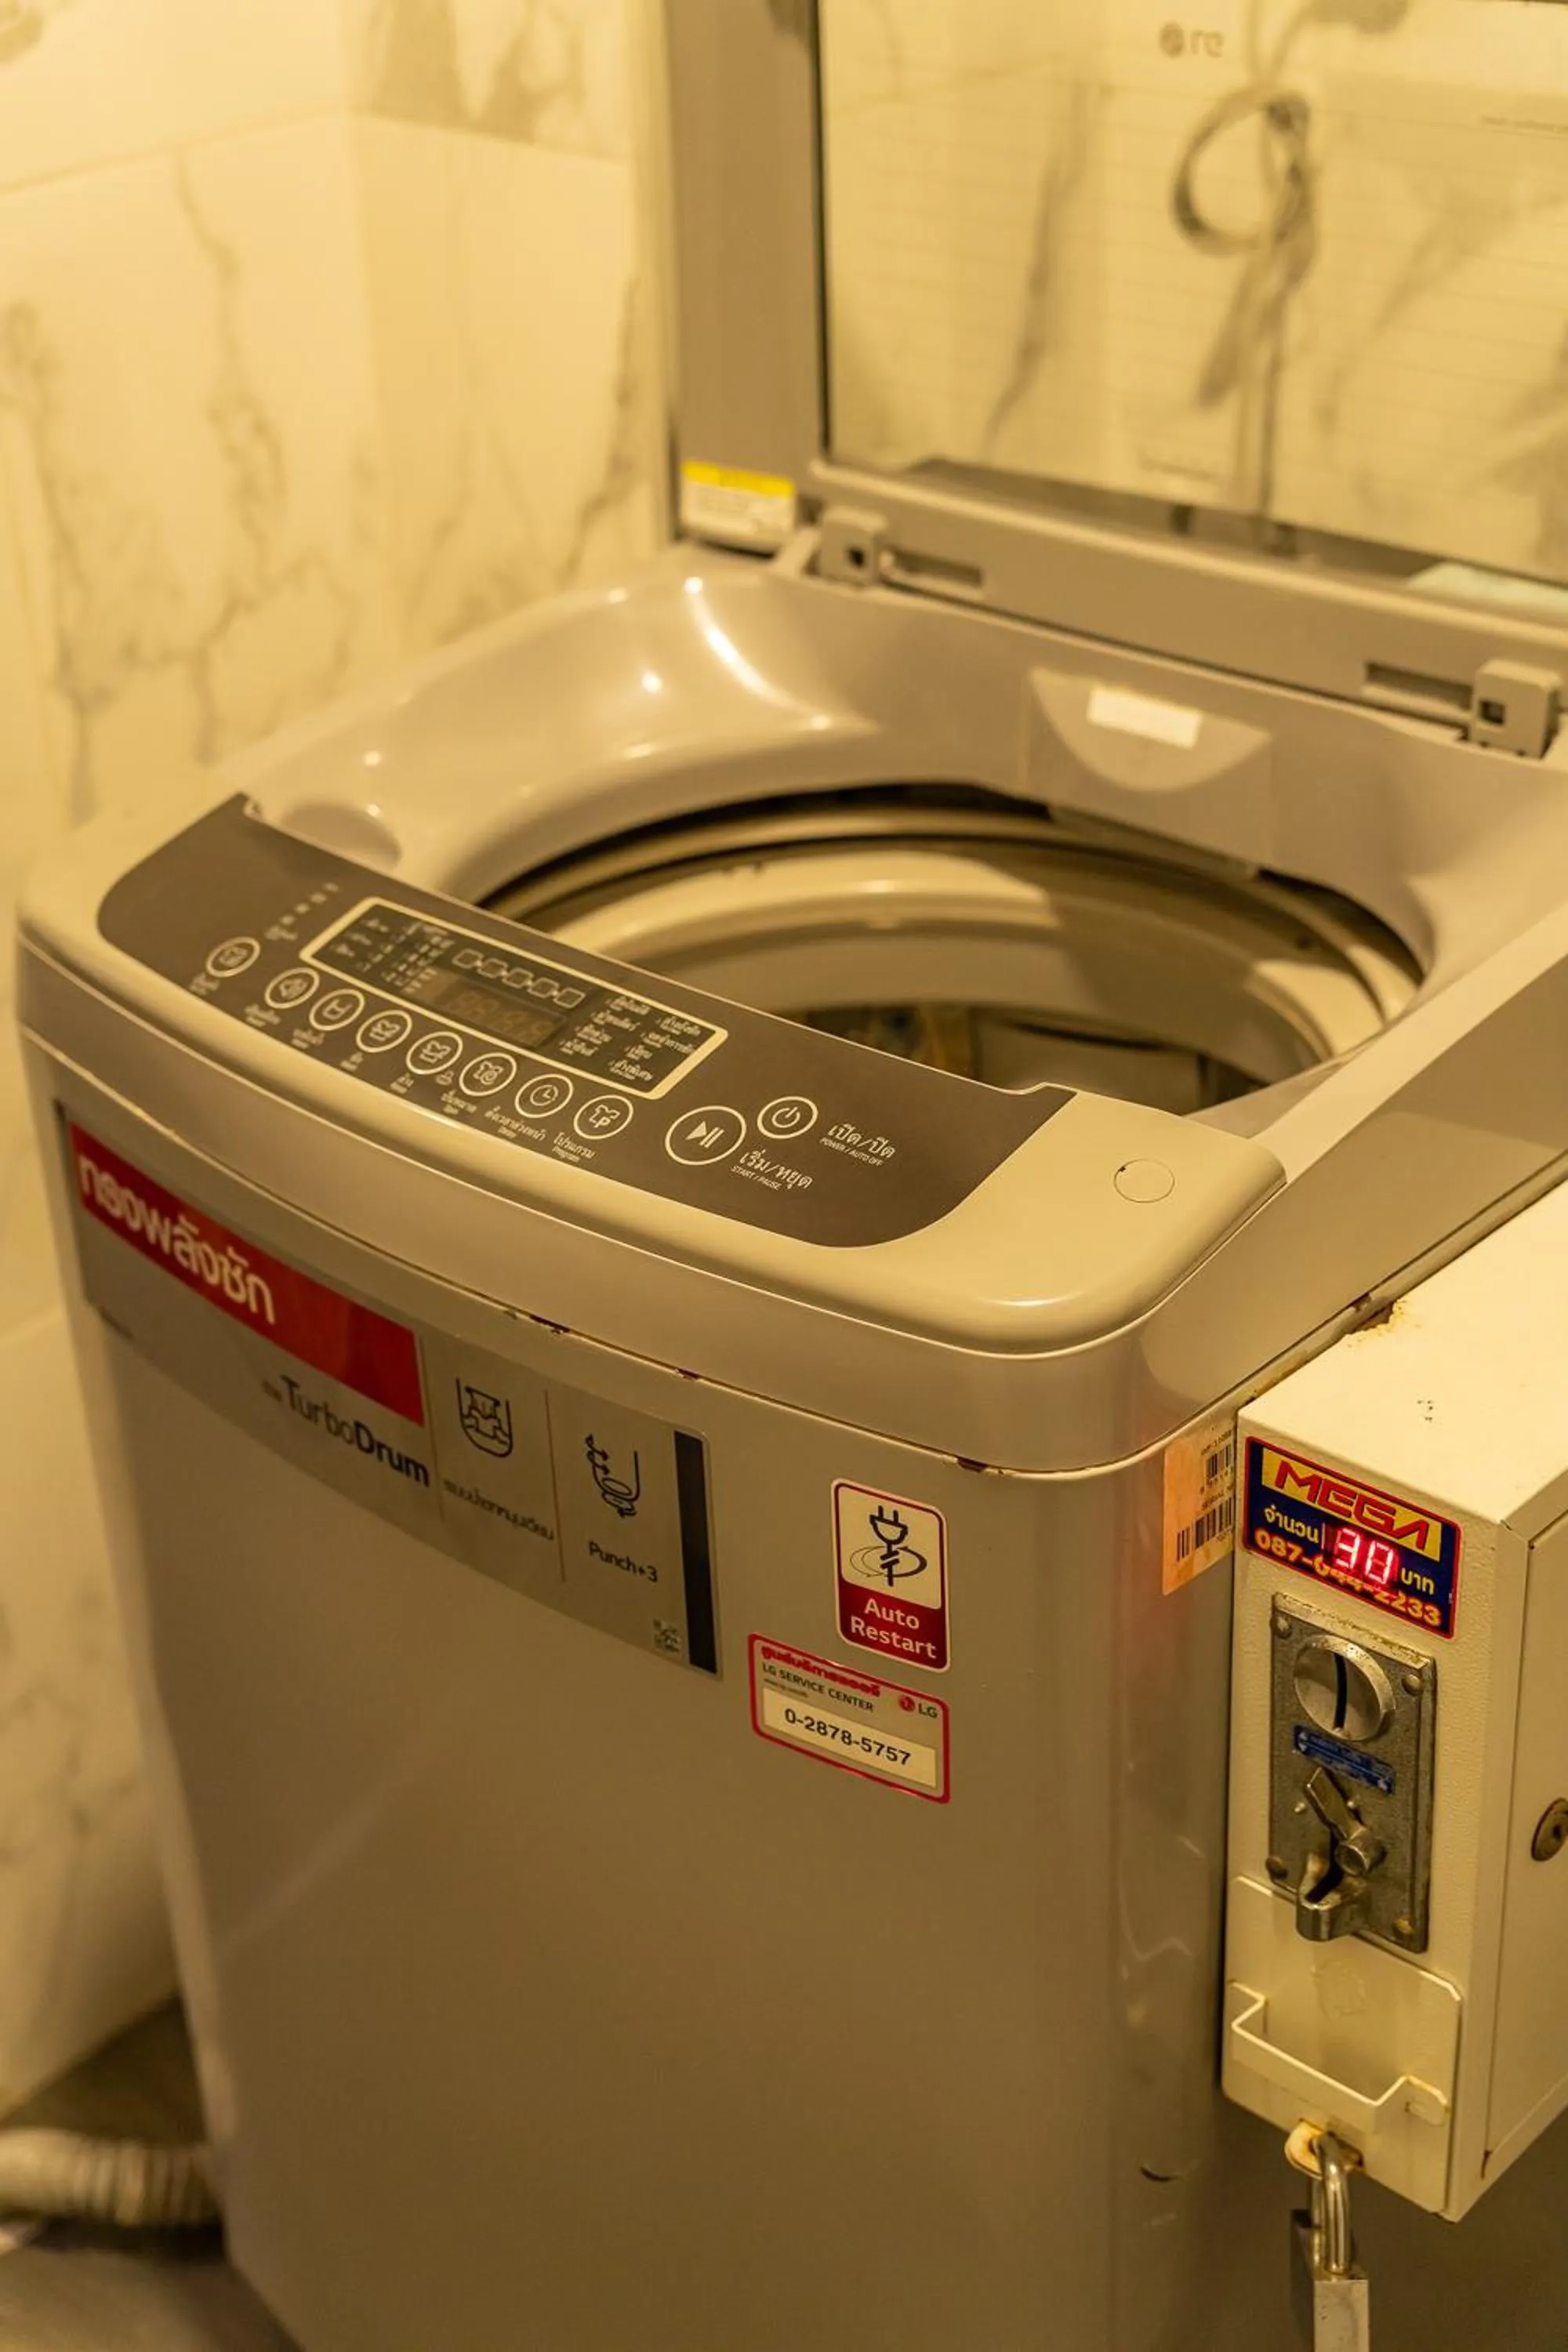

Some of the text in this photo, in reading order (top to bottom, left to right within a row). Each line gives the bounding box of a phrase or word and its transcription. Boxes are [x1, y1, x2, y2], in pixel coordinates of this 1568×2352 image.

[280, 1374, 430, 1488] TurboDrum
[1274, 1459, 1431, 1551] MEGA
[1400, 1568, 1435, 1595] บาท
[864, 1597, 920, 1630] Auto
[851, 1616, 938, 1660] Restart
[762, 1662, 777, 1675] LG
[779, 1668, 826, 1694] SERVICE
[828, 1687, 873, 1713] CENTER
[918, 1698, 939, 1719] LG
[784, 1707, 912, 1766] 0-2878-5757
